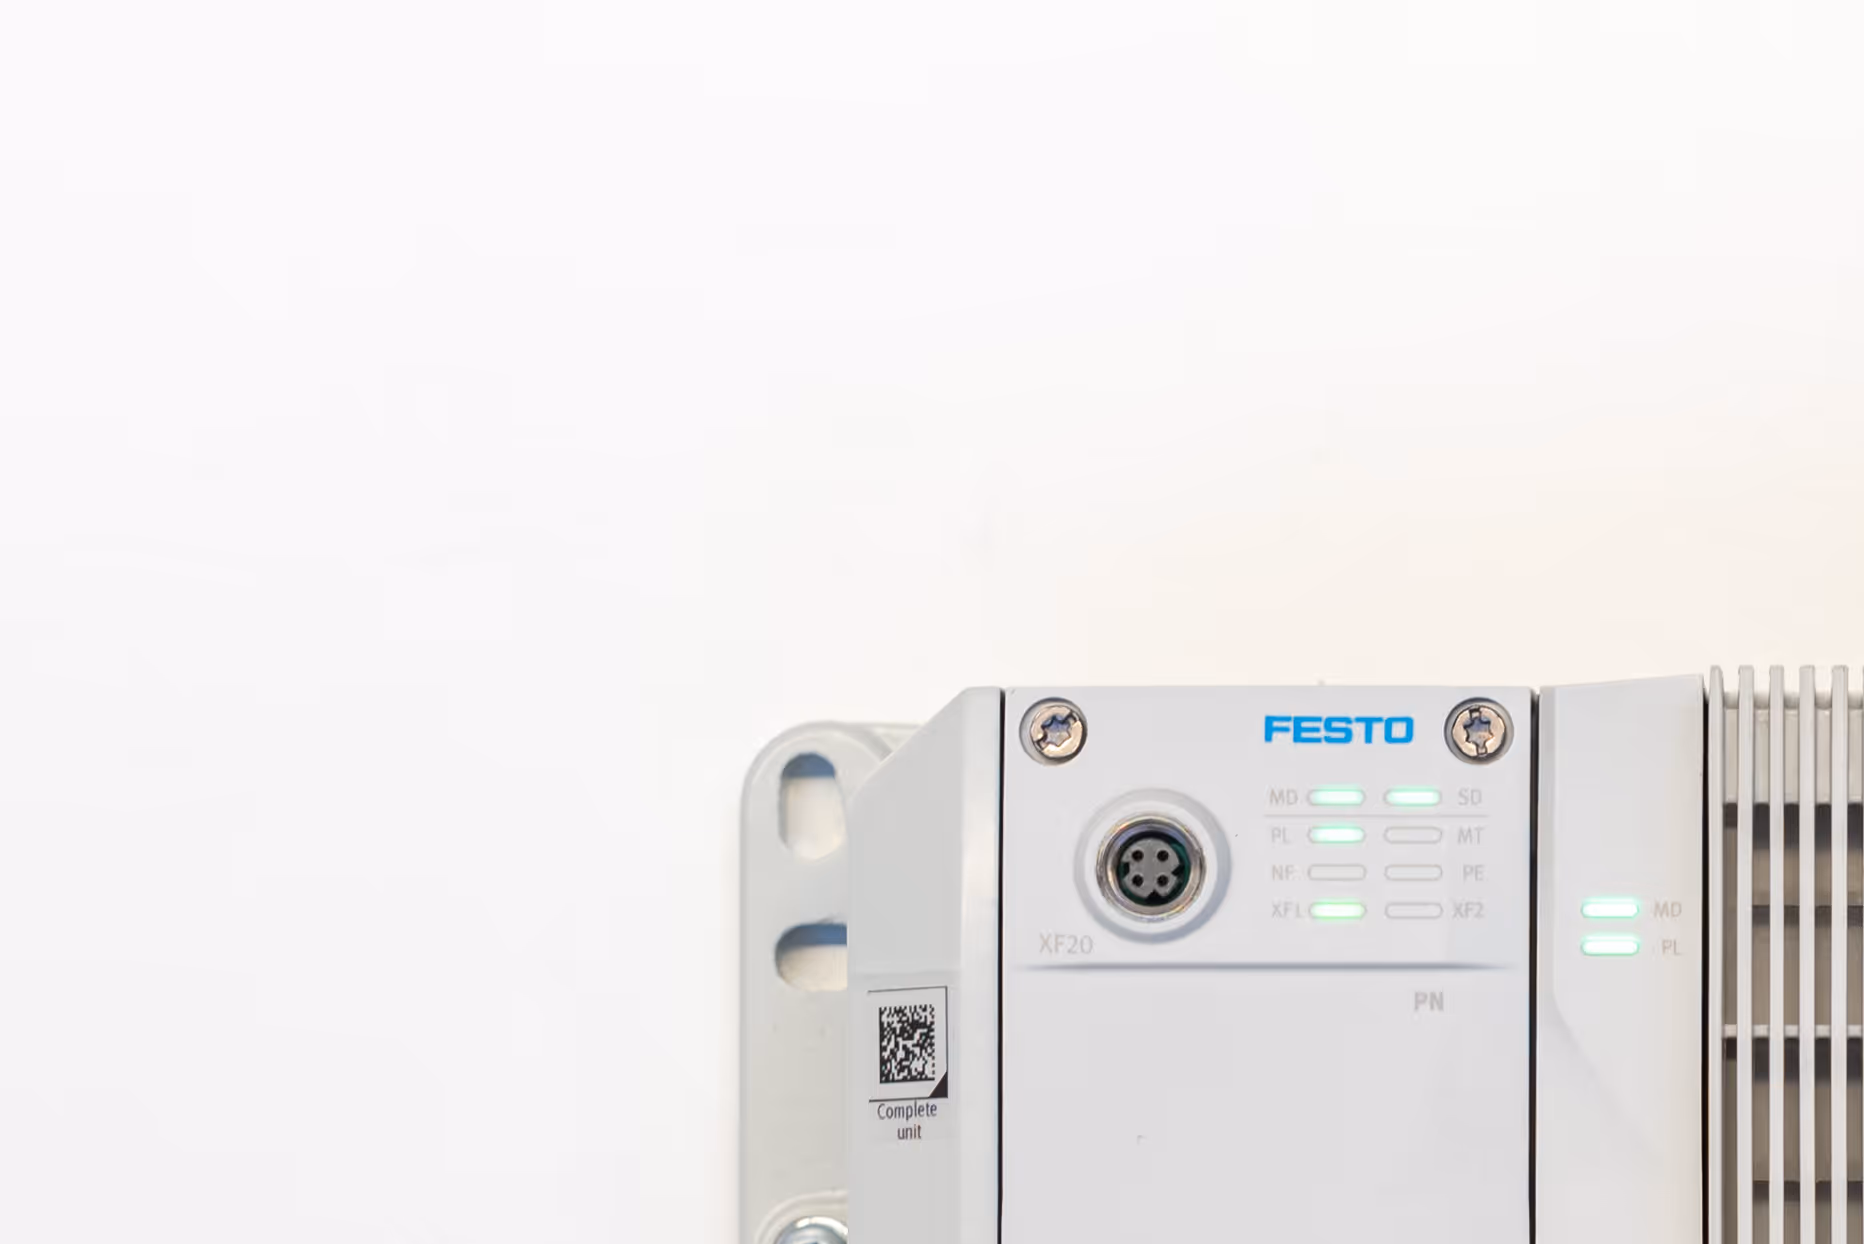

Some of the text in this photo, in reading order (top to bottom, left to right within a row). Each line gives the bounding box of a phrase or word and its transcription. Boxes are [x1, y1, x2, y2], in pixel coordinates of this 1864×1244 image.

[1264, 716, 1414, 744] FESTO
[1269, 788, 1298, 805] MD
[1457, 788, 1482, 806] SD
[1271, 827, 1291, 844] PL
[1457, 827, 1485, 844] MT
[1271, 865, 1295, 881] NF
[1462, 864, 1485, 881] PE
[1452, 902, 1485, 919] XF2
[1652, 901, 1683, 918] MD
[1038, 935, 1093, 955] XF20
[1661, 940, 1683, 956] PL
[1413, 991, 1445, 1012] PN
[877, 1101, 937, 1121] Complete
[897, 1124, 922, 1140] unit
